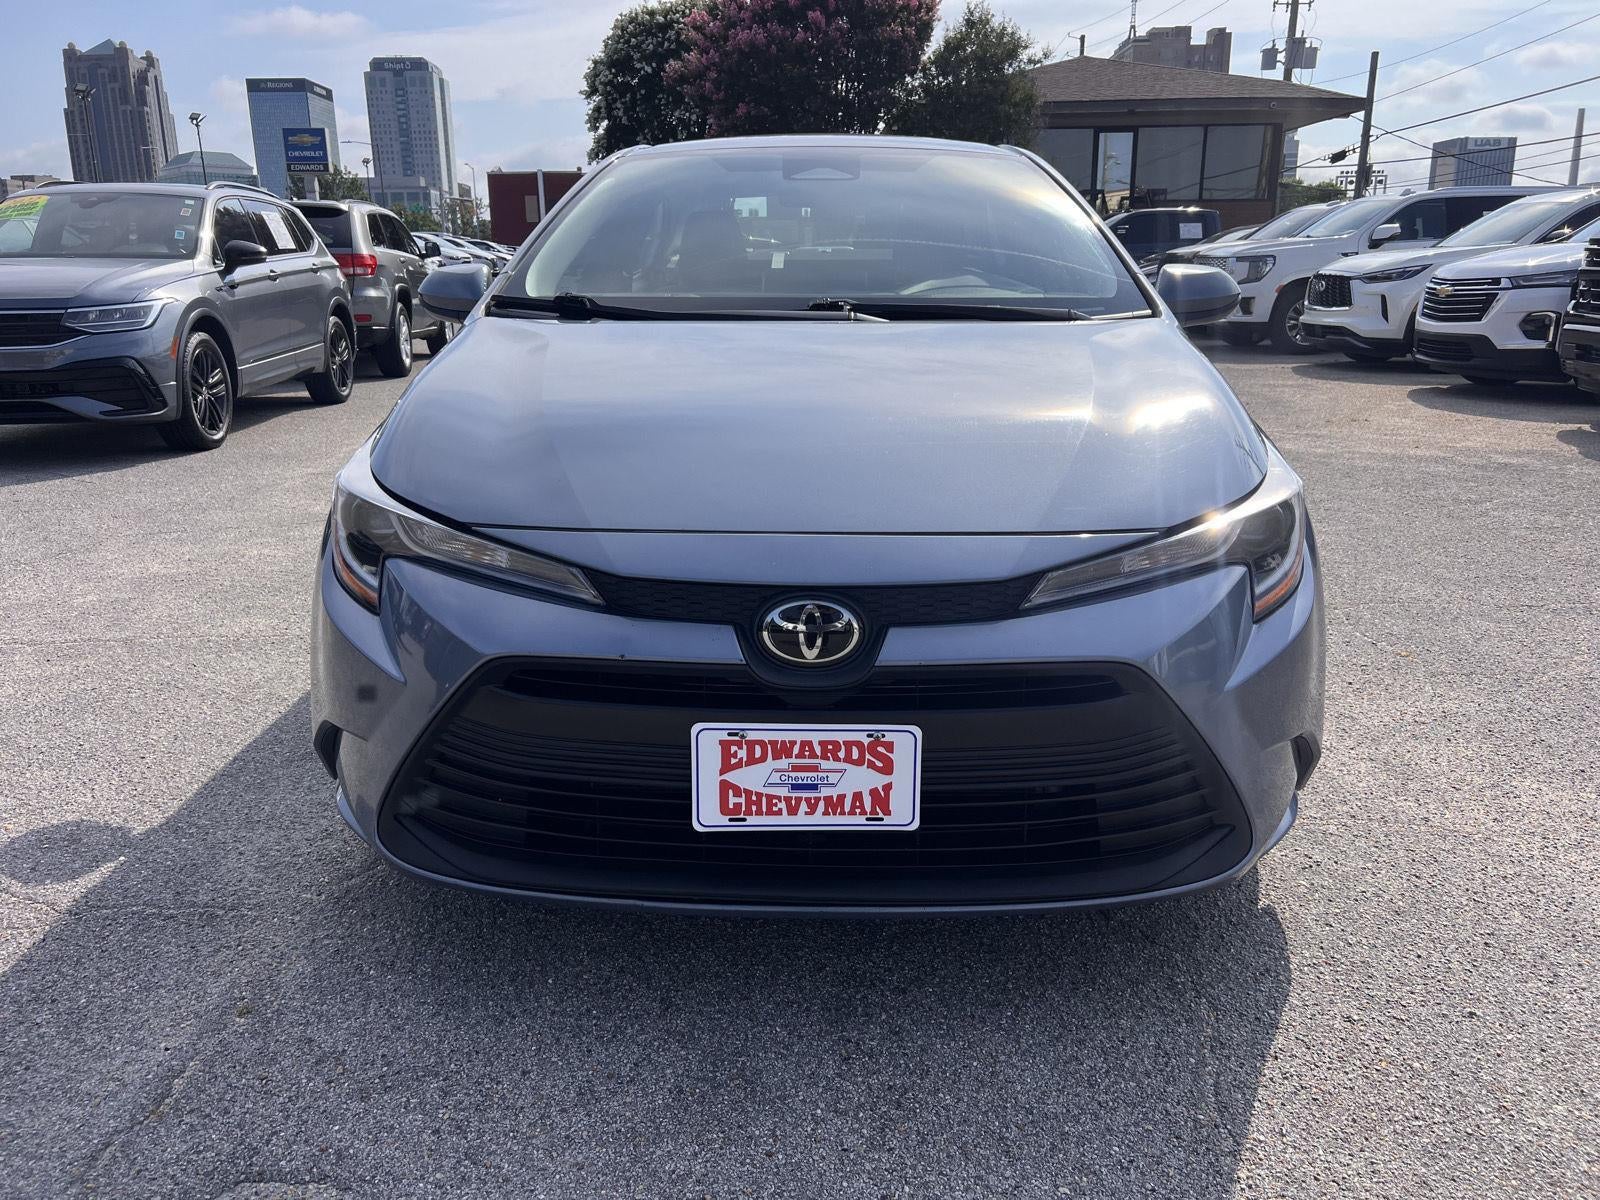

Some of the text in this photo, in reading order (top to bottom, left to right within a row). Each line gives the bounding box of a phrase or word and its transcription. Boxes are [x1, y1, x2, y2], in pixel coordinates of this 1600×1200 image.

[718, 739, 895, 777] EDWARDS
[779, 773, 830, 783] Chevrolet
[718, 778, 893, 817] CHEVYMAN
